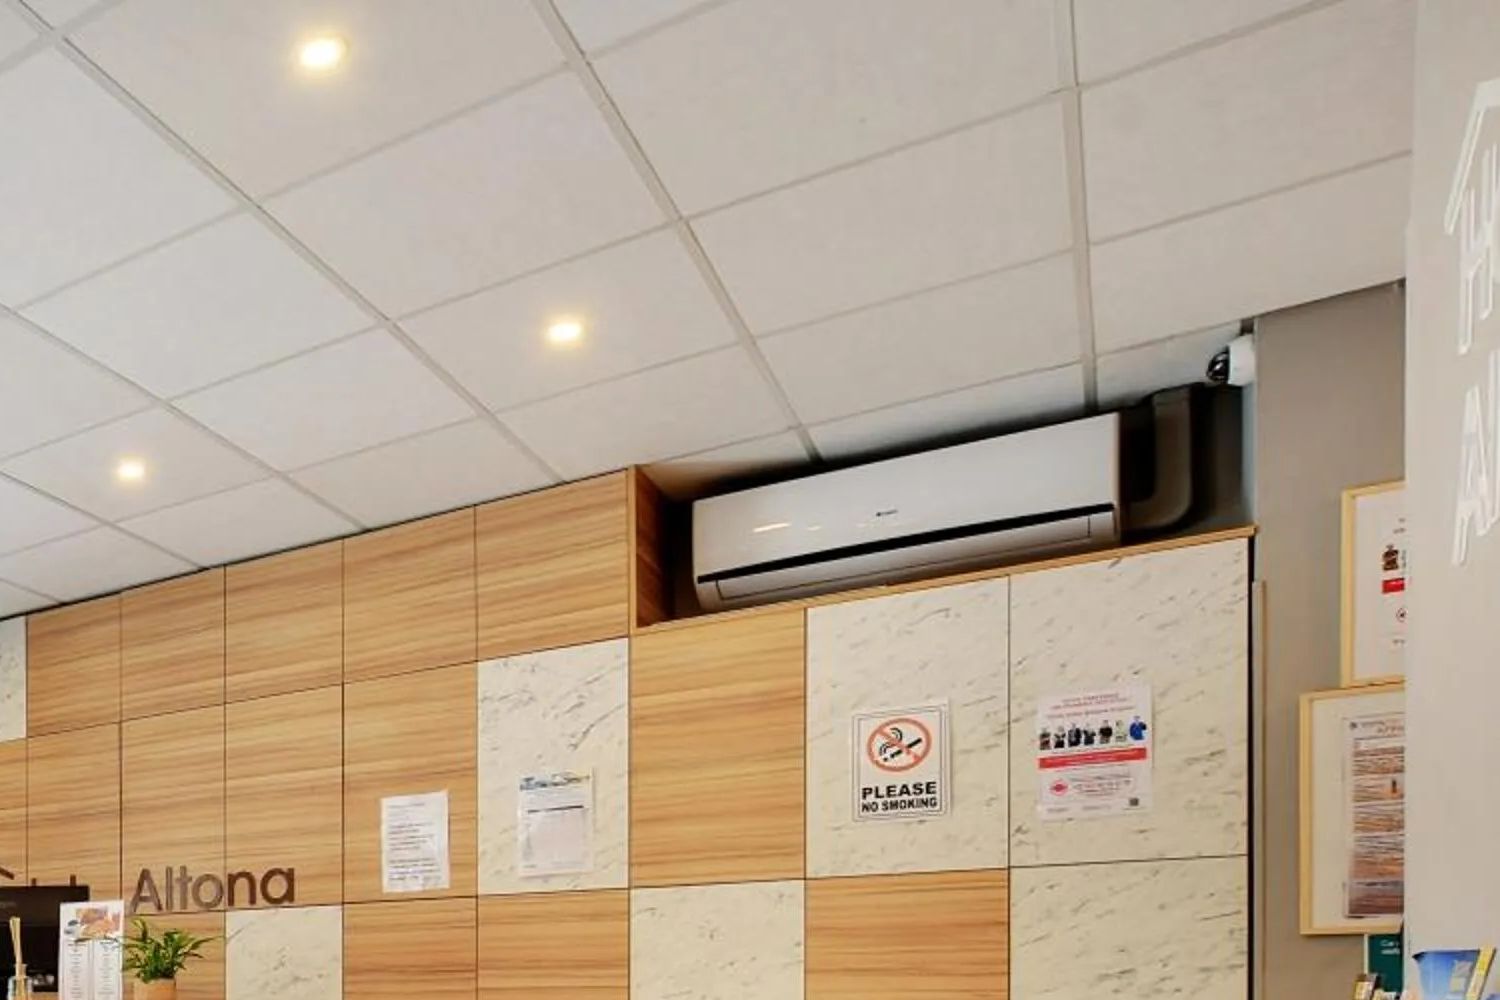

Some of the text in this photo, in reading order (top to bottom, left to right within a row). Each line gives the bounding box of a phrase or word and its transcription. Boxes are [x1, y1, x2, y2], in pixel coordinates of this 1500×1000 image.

[861, 781, 937, 800] PLEASE
[861, 797, 937, 813] NO SMOKING
[130, 865, 295, 914] Altona
